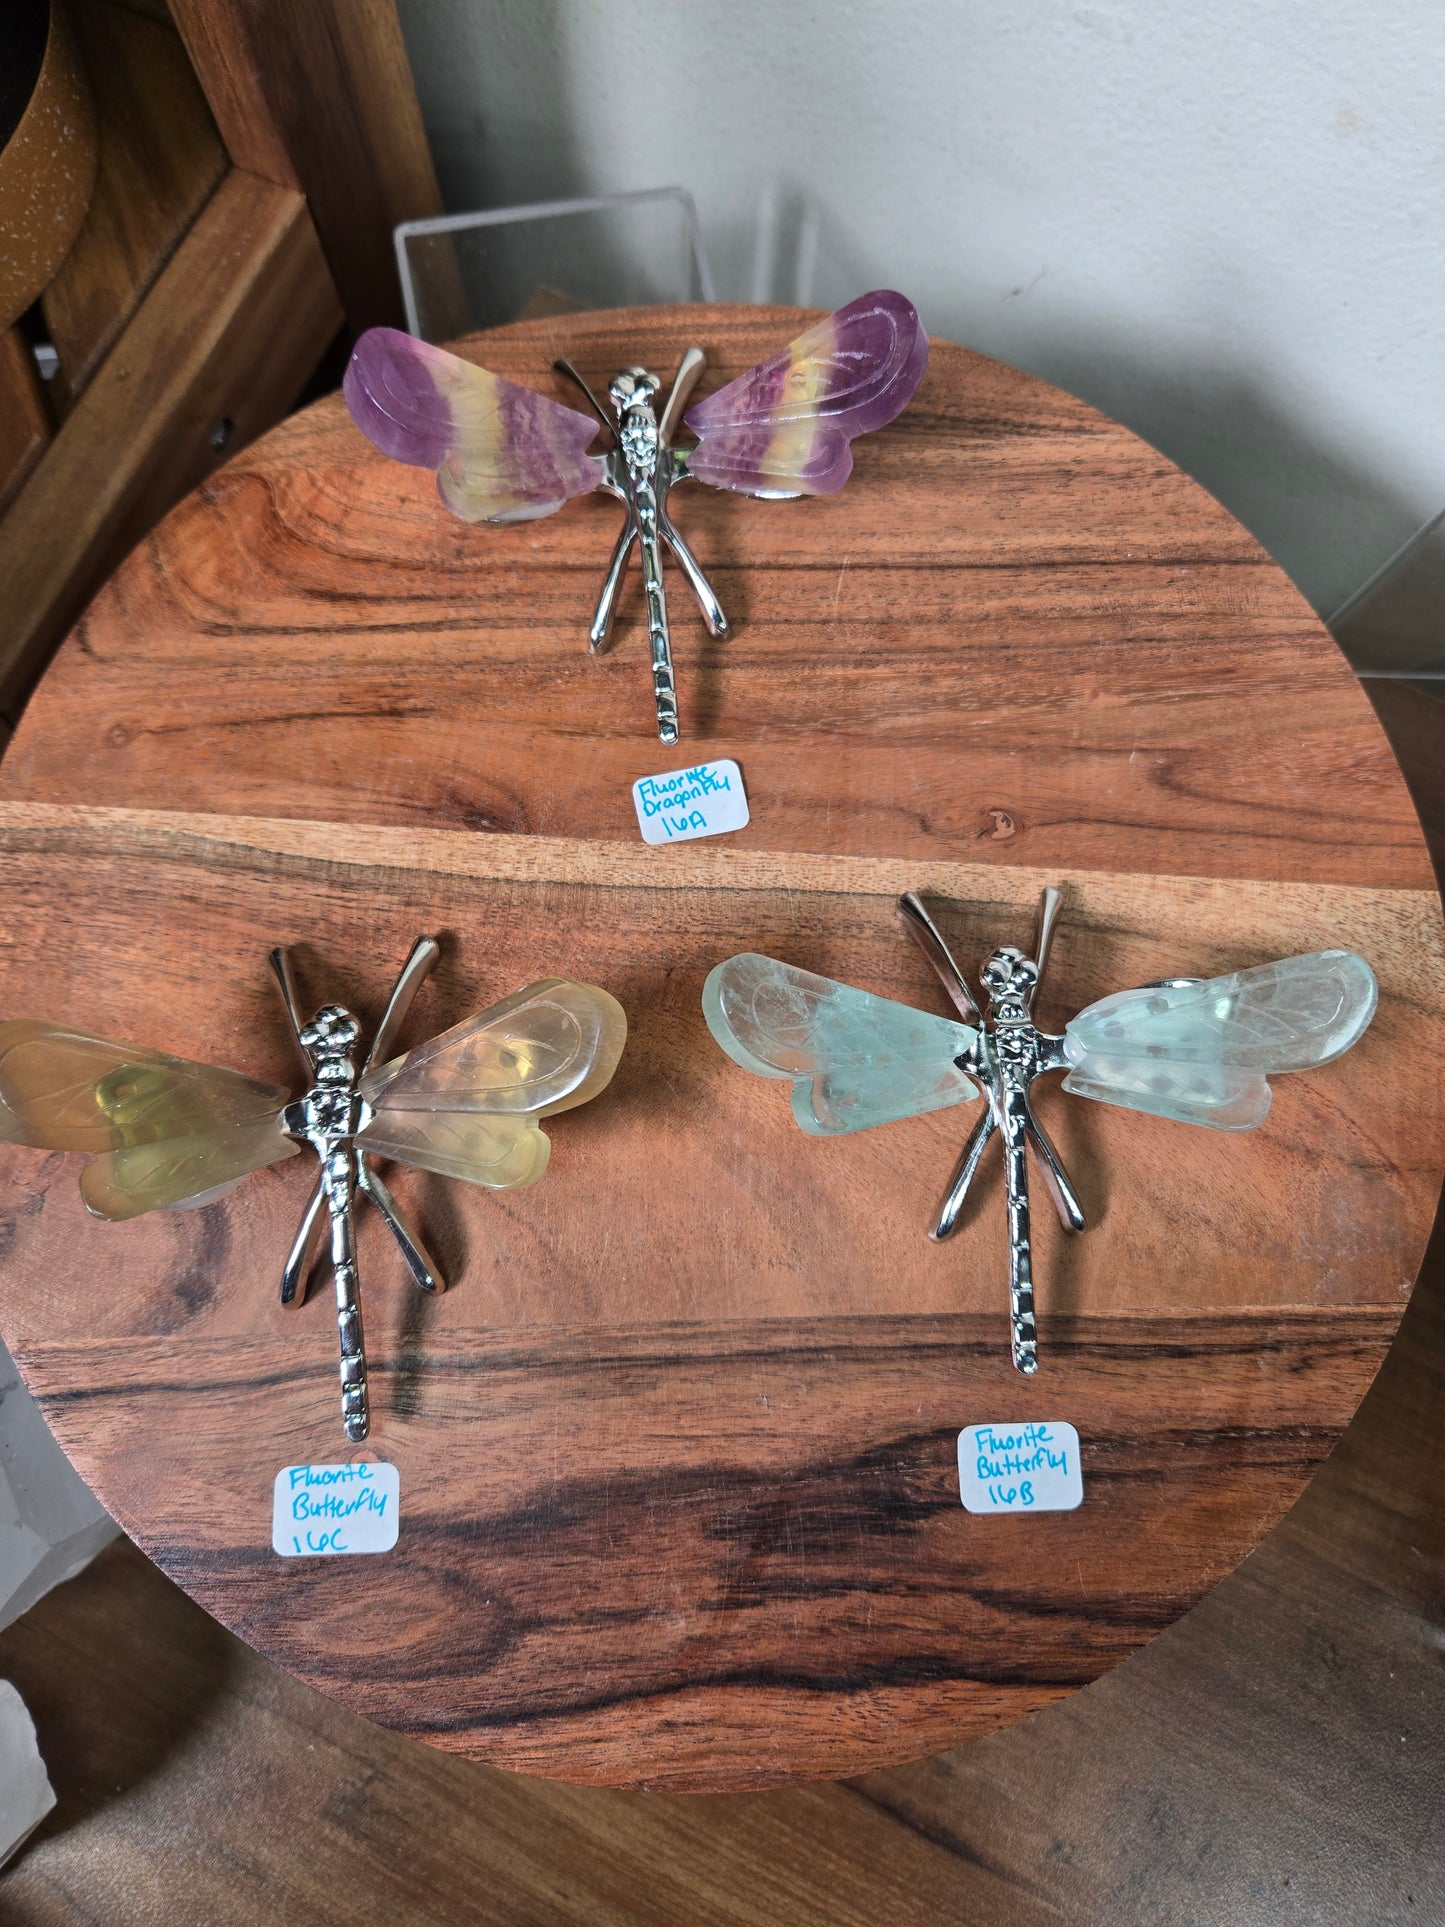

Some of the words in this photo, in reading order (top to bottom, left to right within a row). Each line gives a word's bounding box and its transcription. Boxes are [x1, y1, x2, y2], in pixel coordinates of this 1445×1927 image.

[661, 810, 707, 837] 16A
[975, 1423, 1053, 1454] Fluorite
[289, 1463, 374, 1489] Fluorite
[292, 1487, 387, 1520] Butterfly
[989, 1481, 1034, 1505] 16B
